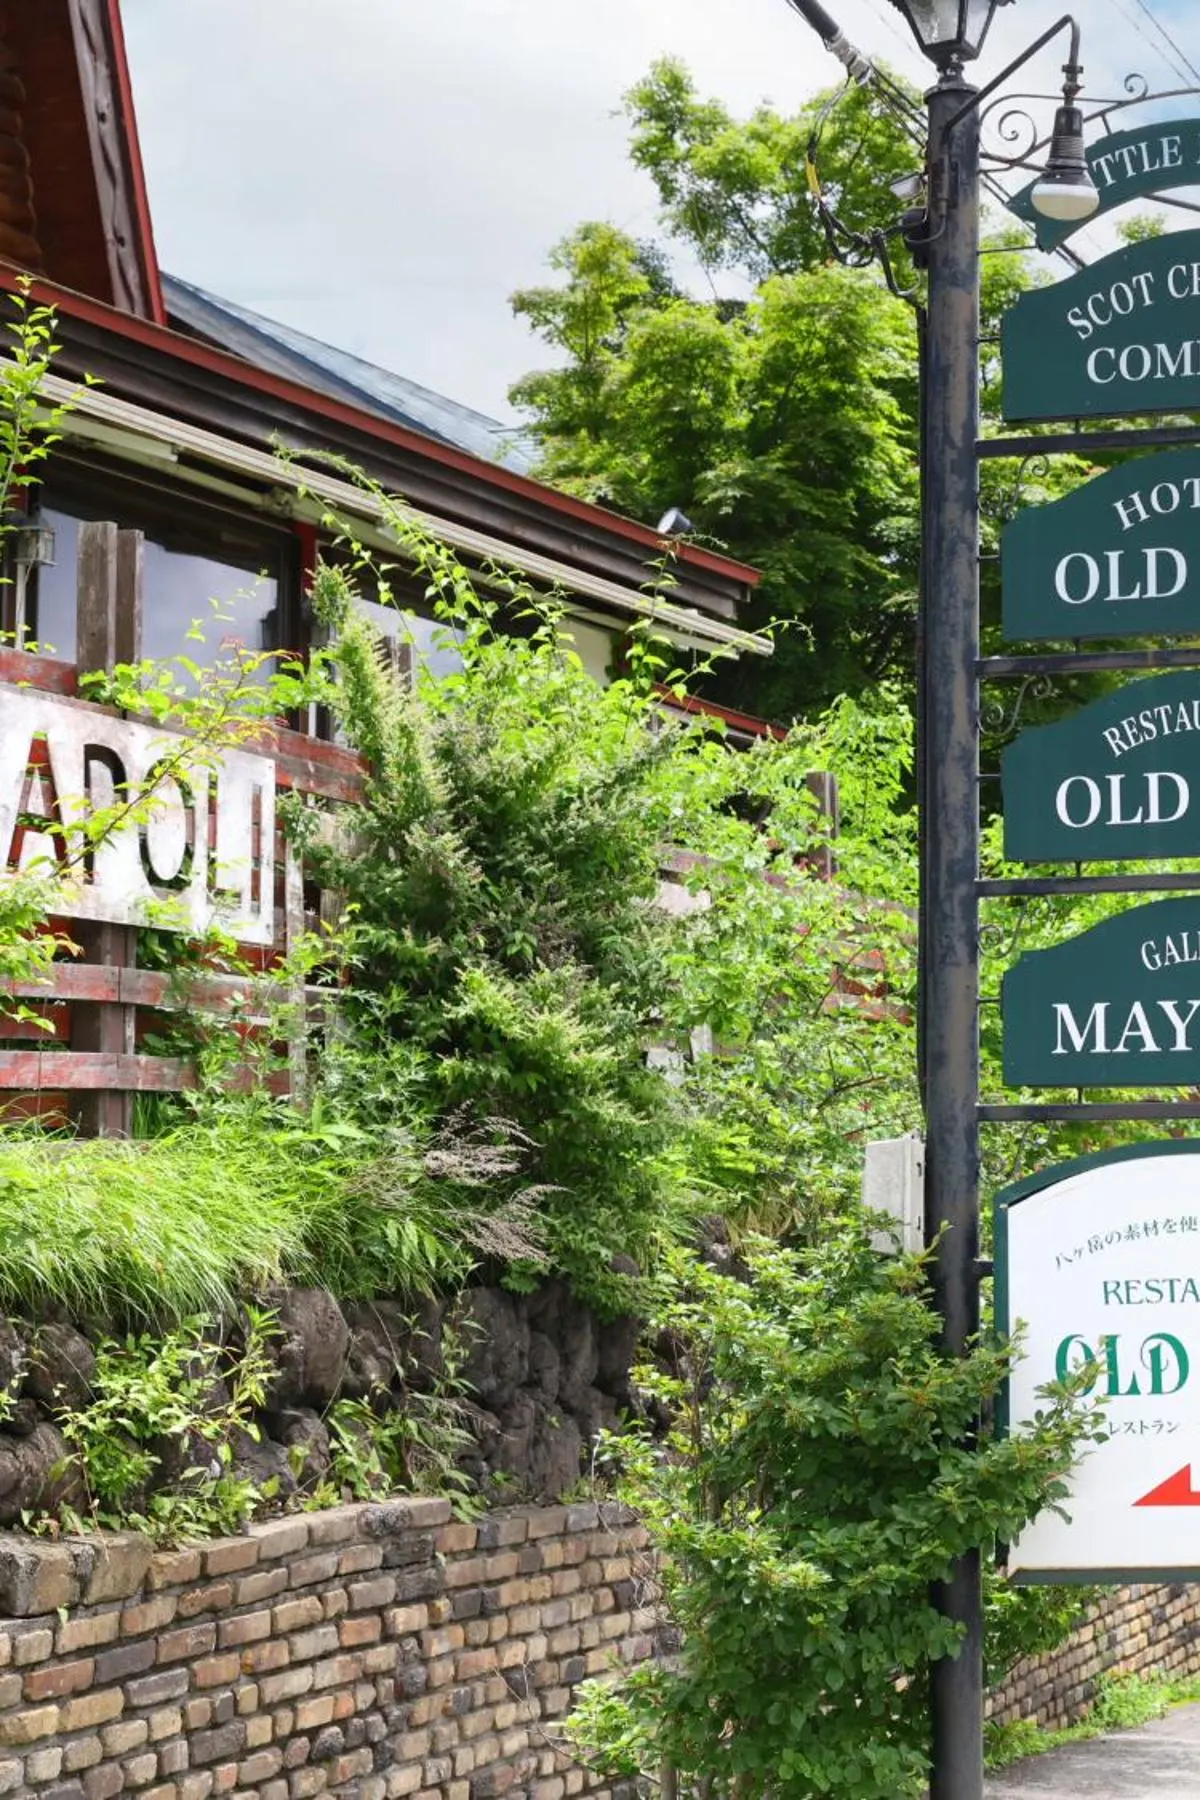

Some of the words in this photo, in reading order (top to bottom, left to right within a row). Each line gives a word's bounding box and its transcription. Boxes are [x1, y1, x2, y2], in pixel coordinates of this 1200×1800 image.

[1092, 135, 1183, 190] TTLE
[1066, 272, 1155, 341] SCOT
[1055, 547, 1188, 604] OLD
[1055, 771, 1190, 829] OLD
[1055, 1332, 1189, 1399] OLD
